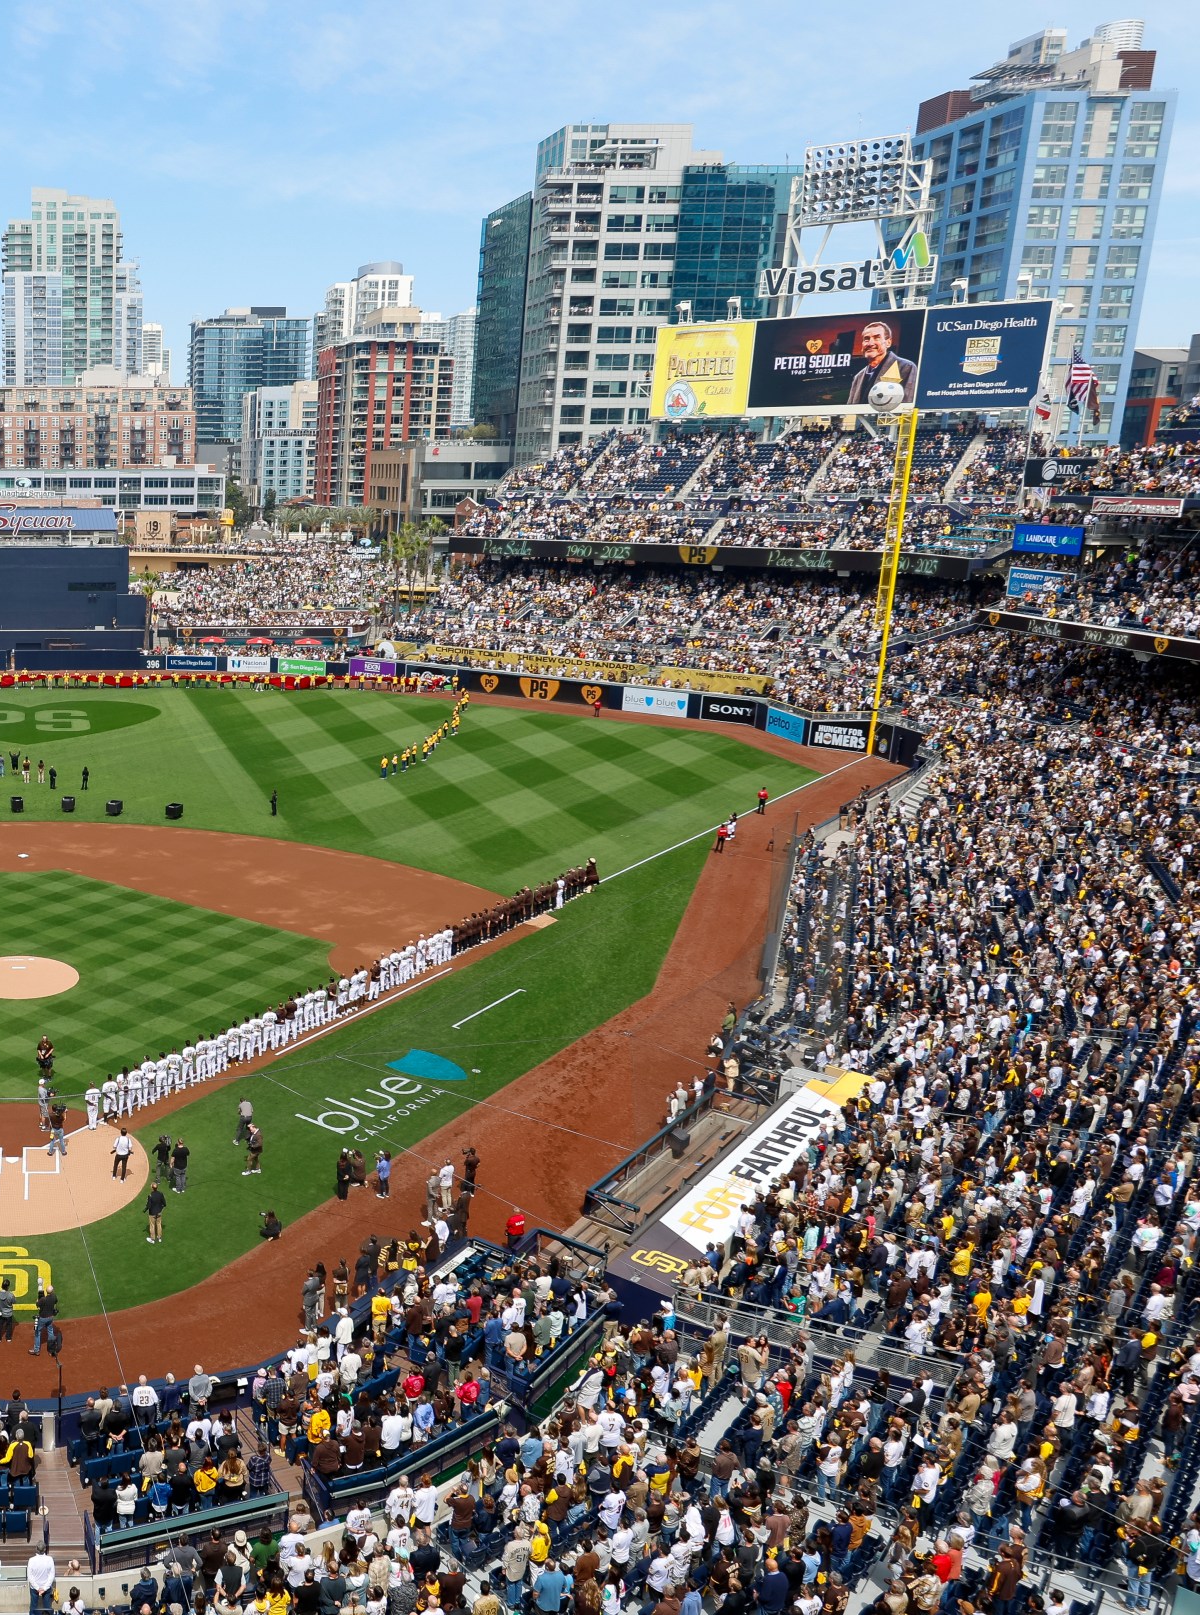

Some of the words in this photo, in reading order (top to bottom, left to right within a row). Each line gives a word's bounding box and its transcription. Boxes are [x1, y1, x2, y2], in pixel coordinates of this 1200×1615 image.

[765, 260, 877, 297] Viasat
[936, 321, 953, 332] UC
[953, 320, 973, 331] San
[974, 319, 1003, 331] Diego
[1003, 317, 1038, 328] Health
[968, 339, 998, 349] BEST
[774, 356, 807, 370] PETER
[809, 353, 851, 368] SEIDLER
[1057, 464, 1081, 475] MRC
[29, 490, 55, 498] Square
[149, 521, 159, 531] 19
[347, 546, 380, 554] Gallagher
[482, 540, 505, 554] Peter
[505, 540, 532, 556] Seidler
[566, 545, 591, 557] 1960
[600, 545, 631, 559] 2023
[766, 550, 794, 567] Peter
[795, 550, 833, 568] Seidler
[915, 559, 938, 573] 2023
[435, 646, 475, 656] CHROME
[478, 650, 505, 658] TOUR
[146, 660, 160, 669] 396
[517, 654, 532, 662] THE
[533, 655, 557, 663] NEW
[557, 658, 588, 667] GOLD
[299, 664, 313, 673] Diego
[484, 678, 494, 688] PS
[529, 679, 549, 699] PS
[586, 689, 596, 699] PS
[625, 693, 645, 704] blue
[656, 698, 676, 708] blue
[709, 703, 753, 717] SONY
[768, 715, 790, 730] petco
[818, 725, 847, 735] HUNGRY
[848, 728, 863, 737] FOR
[814, 732, 867, 749] HOMERS
[295, 1076, 423, 1135] blue
[354, 1088, 446, 1142] CALIFORNIA
[679, 1186, 747, 1233] FOR
[727, 1106, 834, 1184] FAITHFUL
[140, 1395, 150, 1405] 23
[609, 1423, 615, 1432] 7
